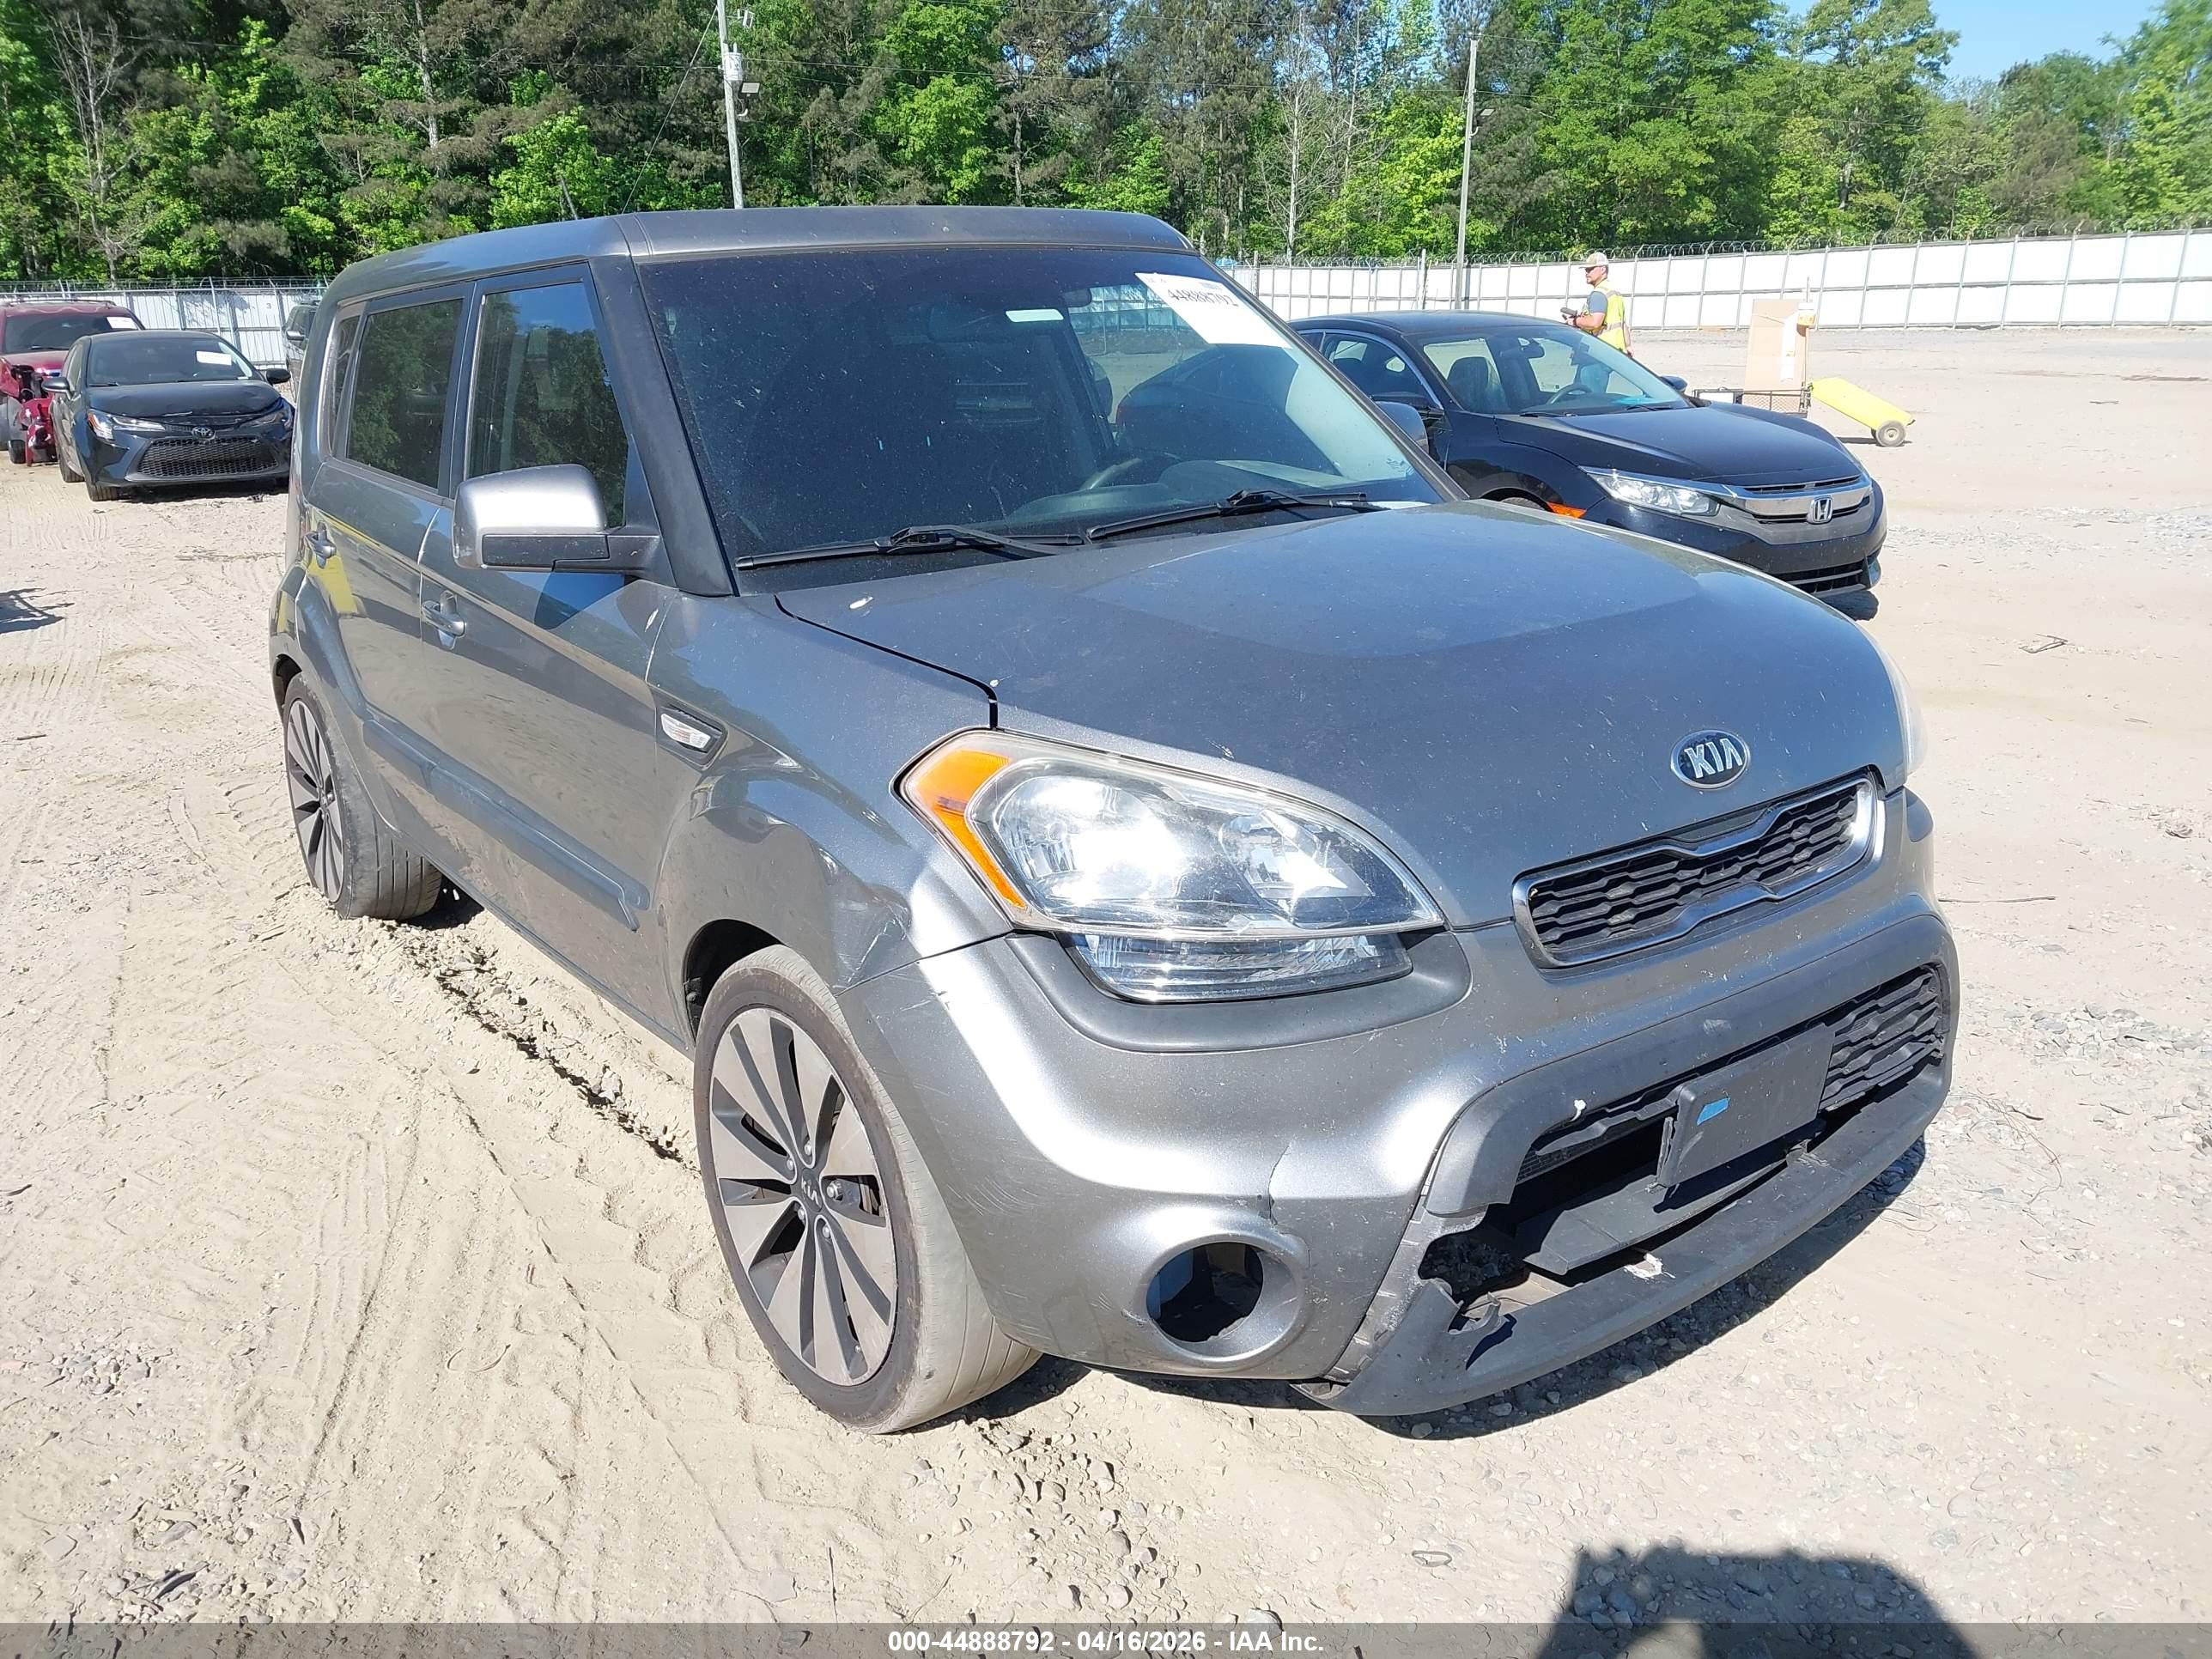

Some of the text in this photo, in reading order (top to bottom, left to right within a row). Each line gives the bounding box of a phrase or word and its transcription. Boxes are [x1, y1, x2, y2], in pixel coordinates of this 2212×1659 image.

[1167, 289, 1239, 307] 44888792
[1684, 738, 1743, 779] KIA
[801, 1176, 820, 1206] KIA
